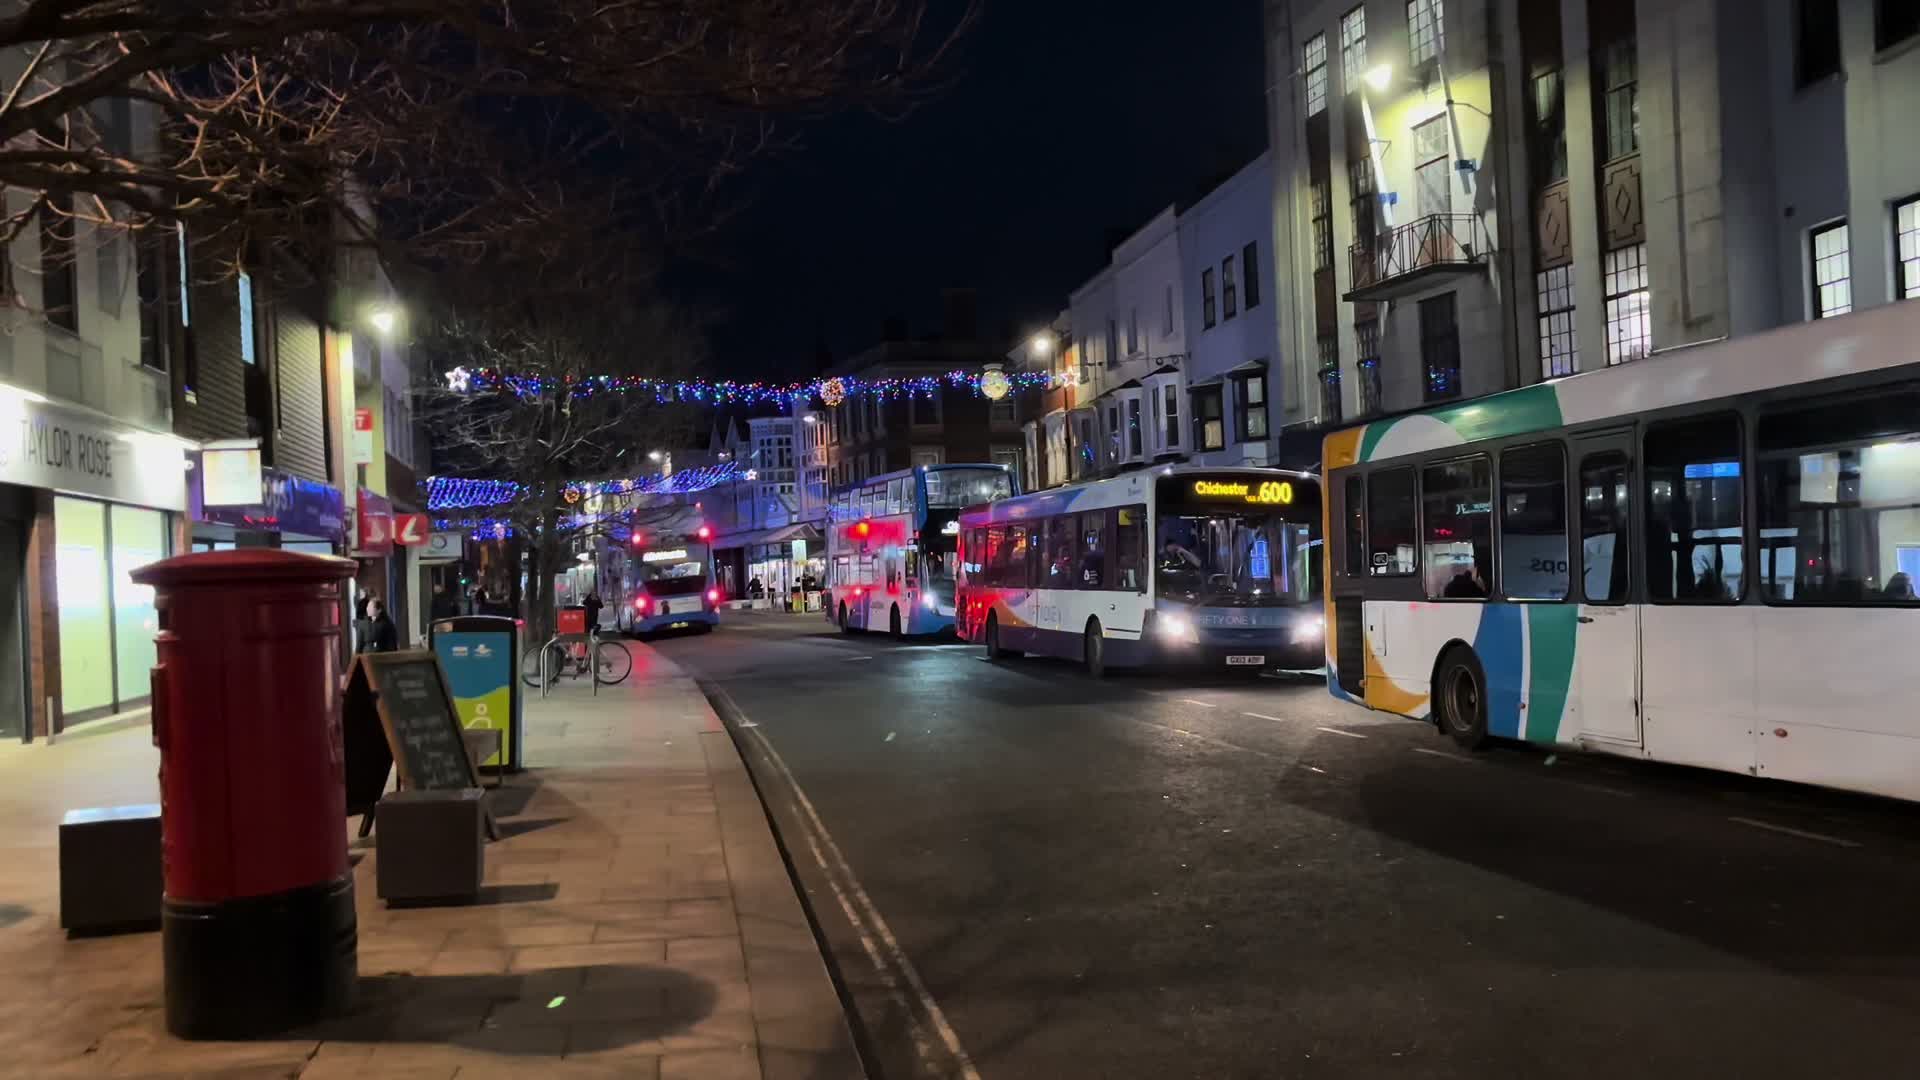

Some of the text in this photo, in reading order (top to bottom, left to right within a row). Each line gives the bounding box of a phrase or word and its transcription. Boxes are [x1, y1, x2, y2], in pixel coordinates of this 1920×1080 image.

[19, 419, 73, 470] TAYLOR
[78, 432, 112, 478] ROSE
[1194, 480, 1292, 503] Chichester 600
[1226, 615, 1249, 625] ONE
